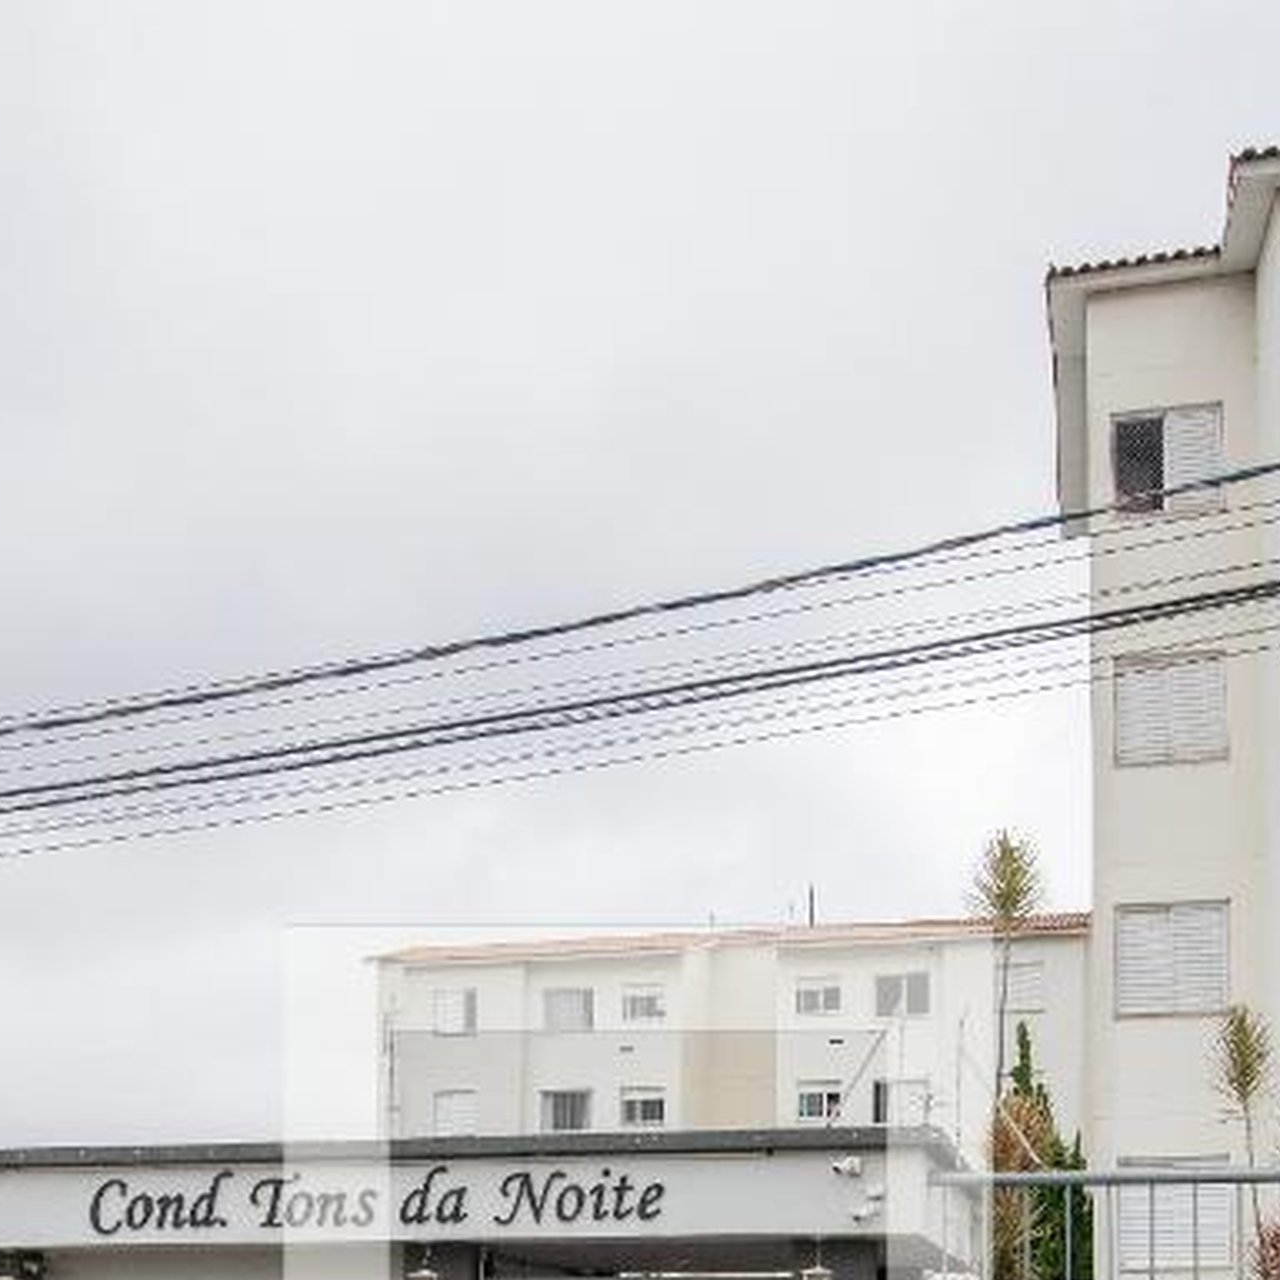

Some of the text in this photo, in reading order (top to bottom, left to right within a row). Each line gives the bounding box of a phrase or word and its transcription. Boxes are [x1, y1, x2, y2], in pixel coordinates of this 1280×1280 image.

[88, 1166, 666, 1236] Cond. Tons da Noite
